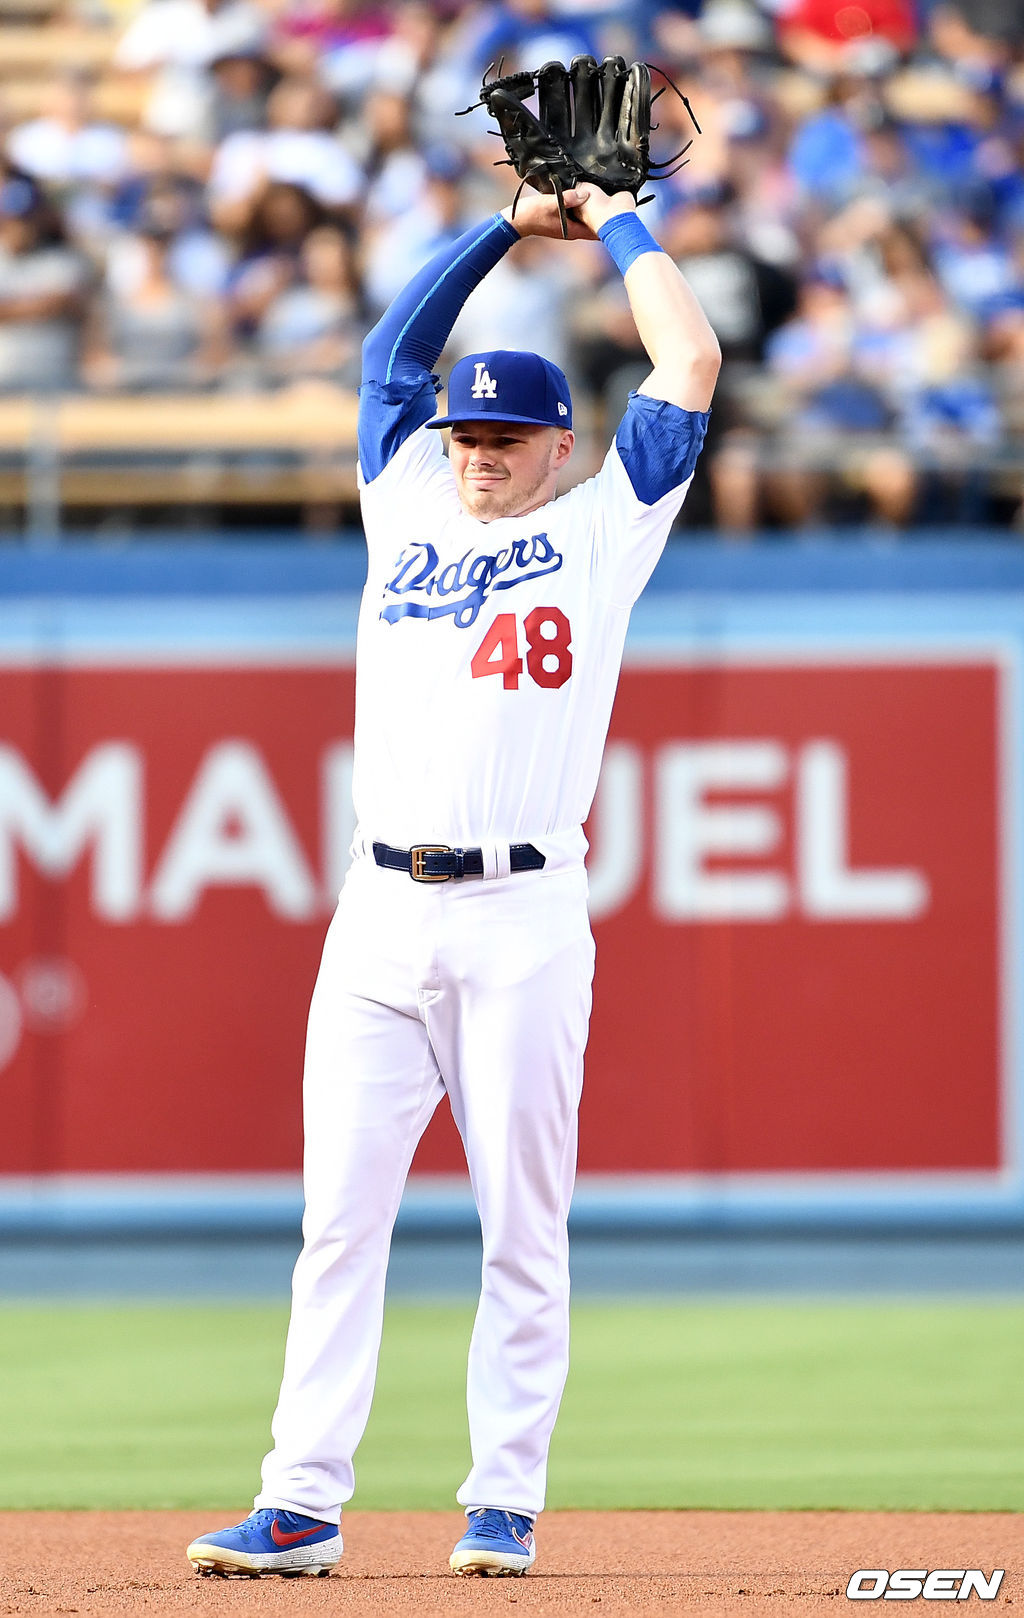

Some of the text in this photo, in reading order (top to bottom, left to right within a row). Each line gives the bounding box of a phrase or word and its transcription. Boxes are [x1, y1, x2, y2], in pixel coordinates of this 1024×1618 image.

[471, 362, 498, 399] LA
[380, 532, 563, 628] Ddgers
[471, 606, 573, 690] 48
[0, 740, 930, 922] MAEL
